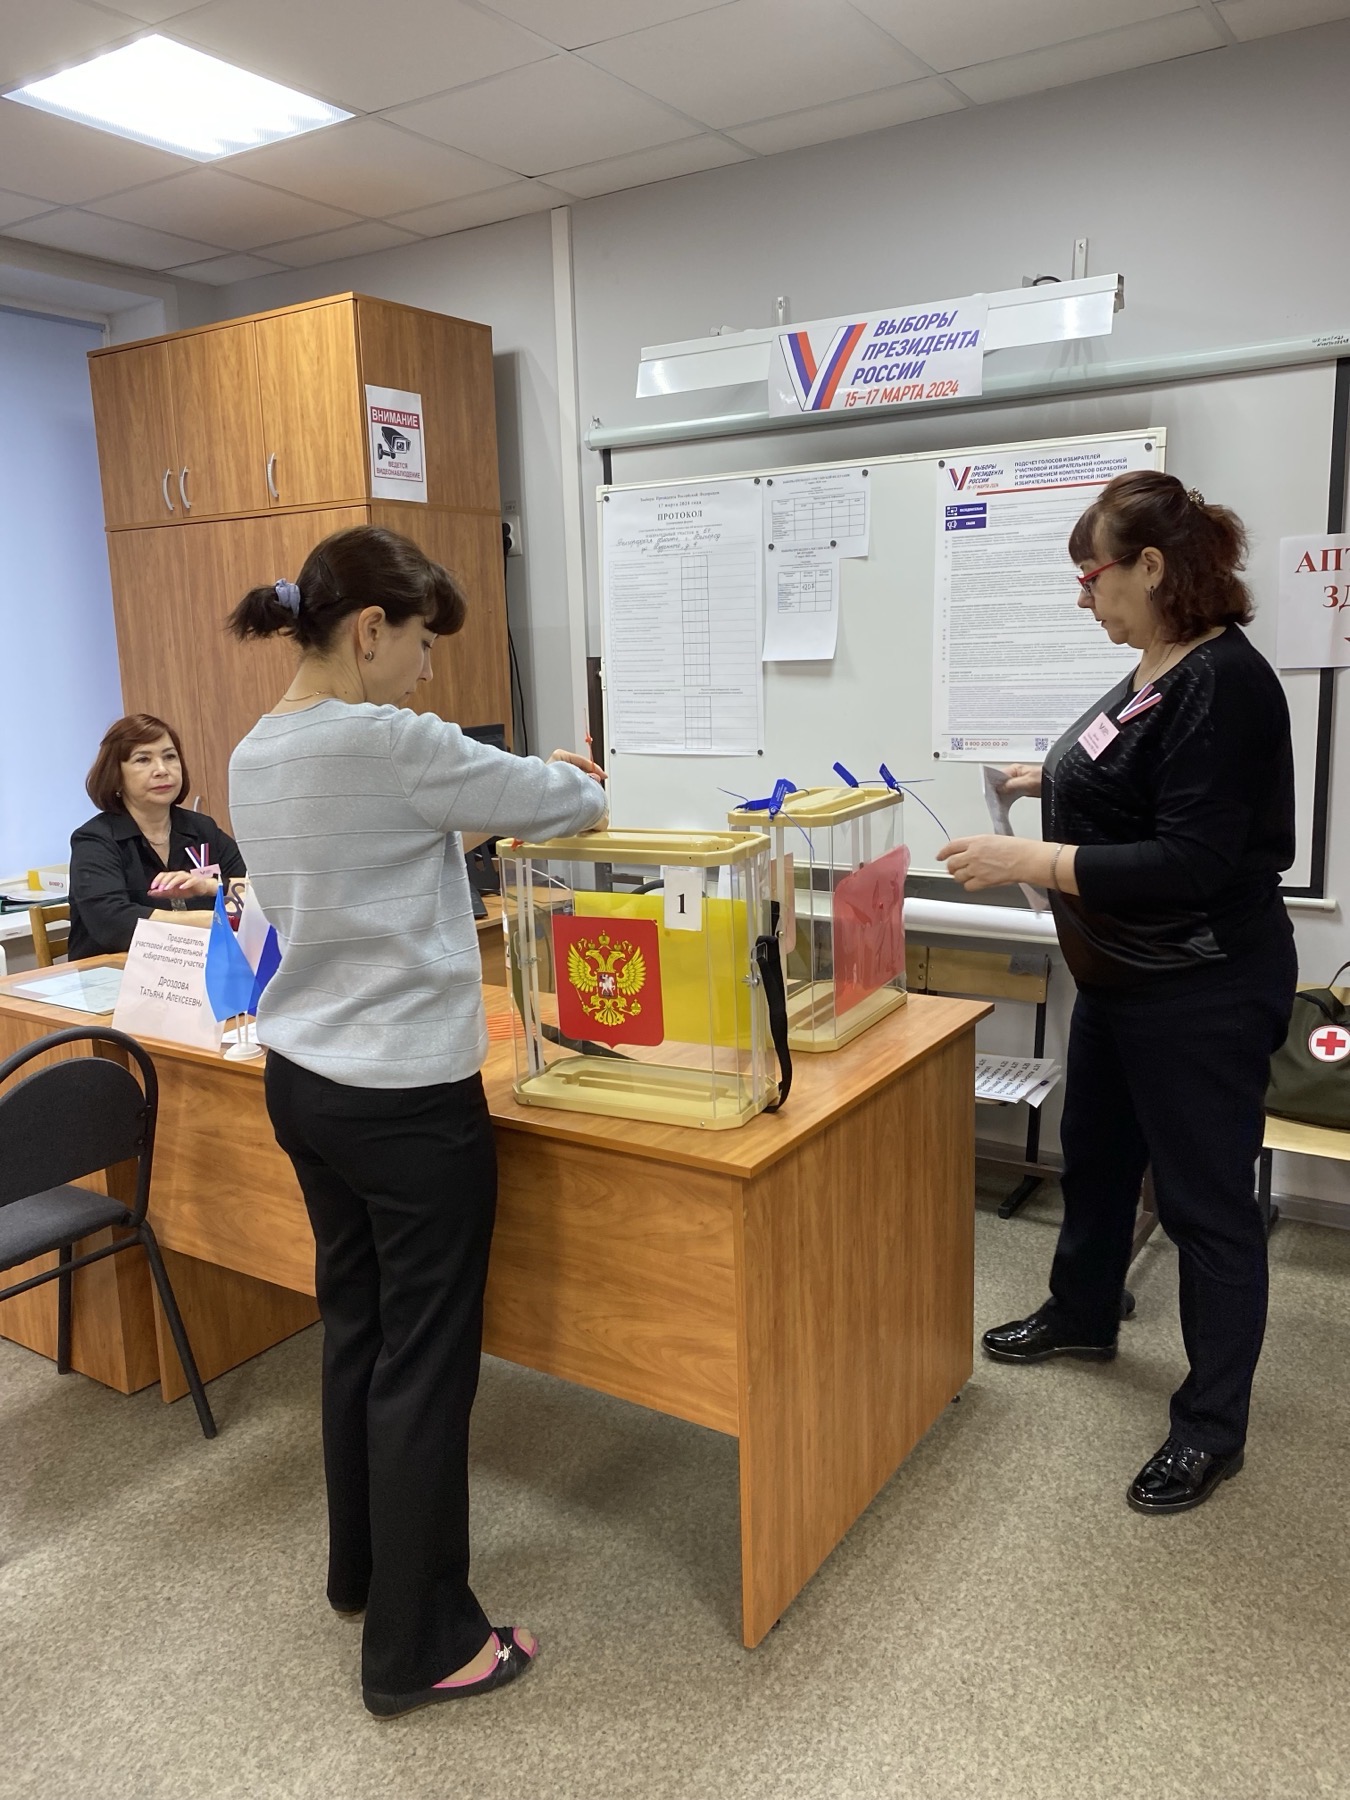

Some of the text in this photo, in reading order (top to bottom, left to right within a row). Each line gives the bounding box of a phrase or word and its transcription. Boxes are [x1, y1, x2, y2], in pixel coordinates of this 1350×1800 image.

[873, 310, 958, 337] ВЫБОРЫ
[861, 329, 981, 361] ПРЕЗИДЕНТА
[850, 360, 926, 385] РОССИИ
[879, 384, 924, 404] МАРТА
[925, 379, 960, 399] 2024
[372, 409, 419, 427] ВНИМАНИЕ
[388, 461, 408, 469] ВЕДЕТСЯ
[1038, 457, 1063, 466] ГОЛОСОВ
[376, 467, 421, 478] ВИДЕОНАБЛЮДЕНИЕ
[657, 510, 704, 522] ПРОТОКОЛ
[677, 893, 687, 914] 1
[168, 934, 204, 946] Председатель
[135, 941, 203, 956] участковой избирательной
[143, 952, 204, 968] избирательного участка
